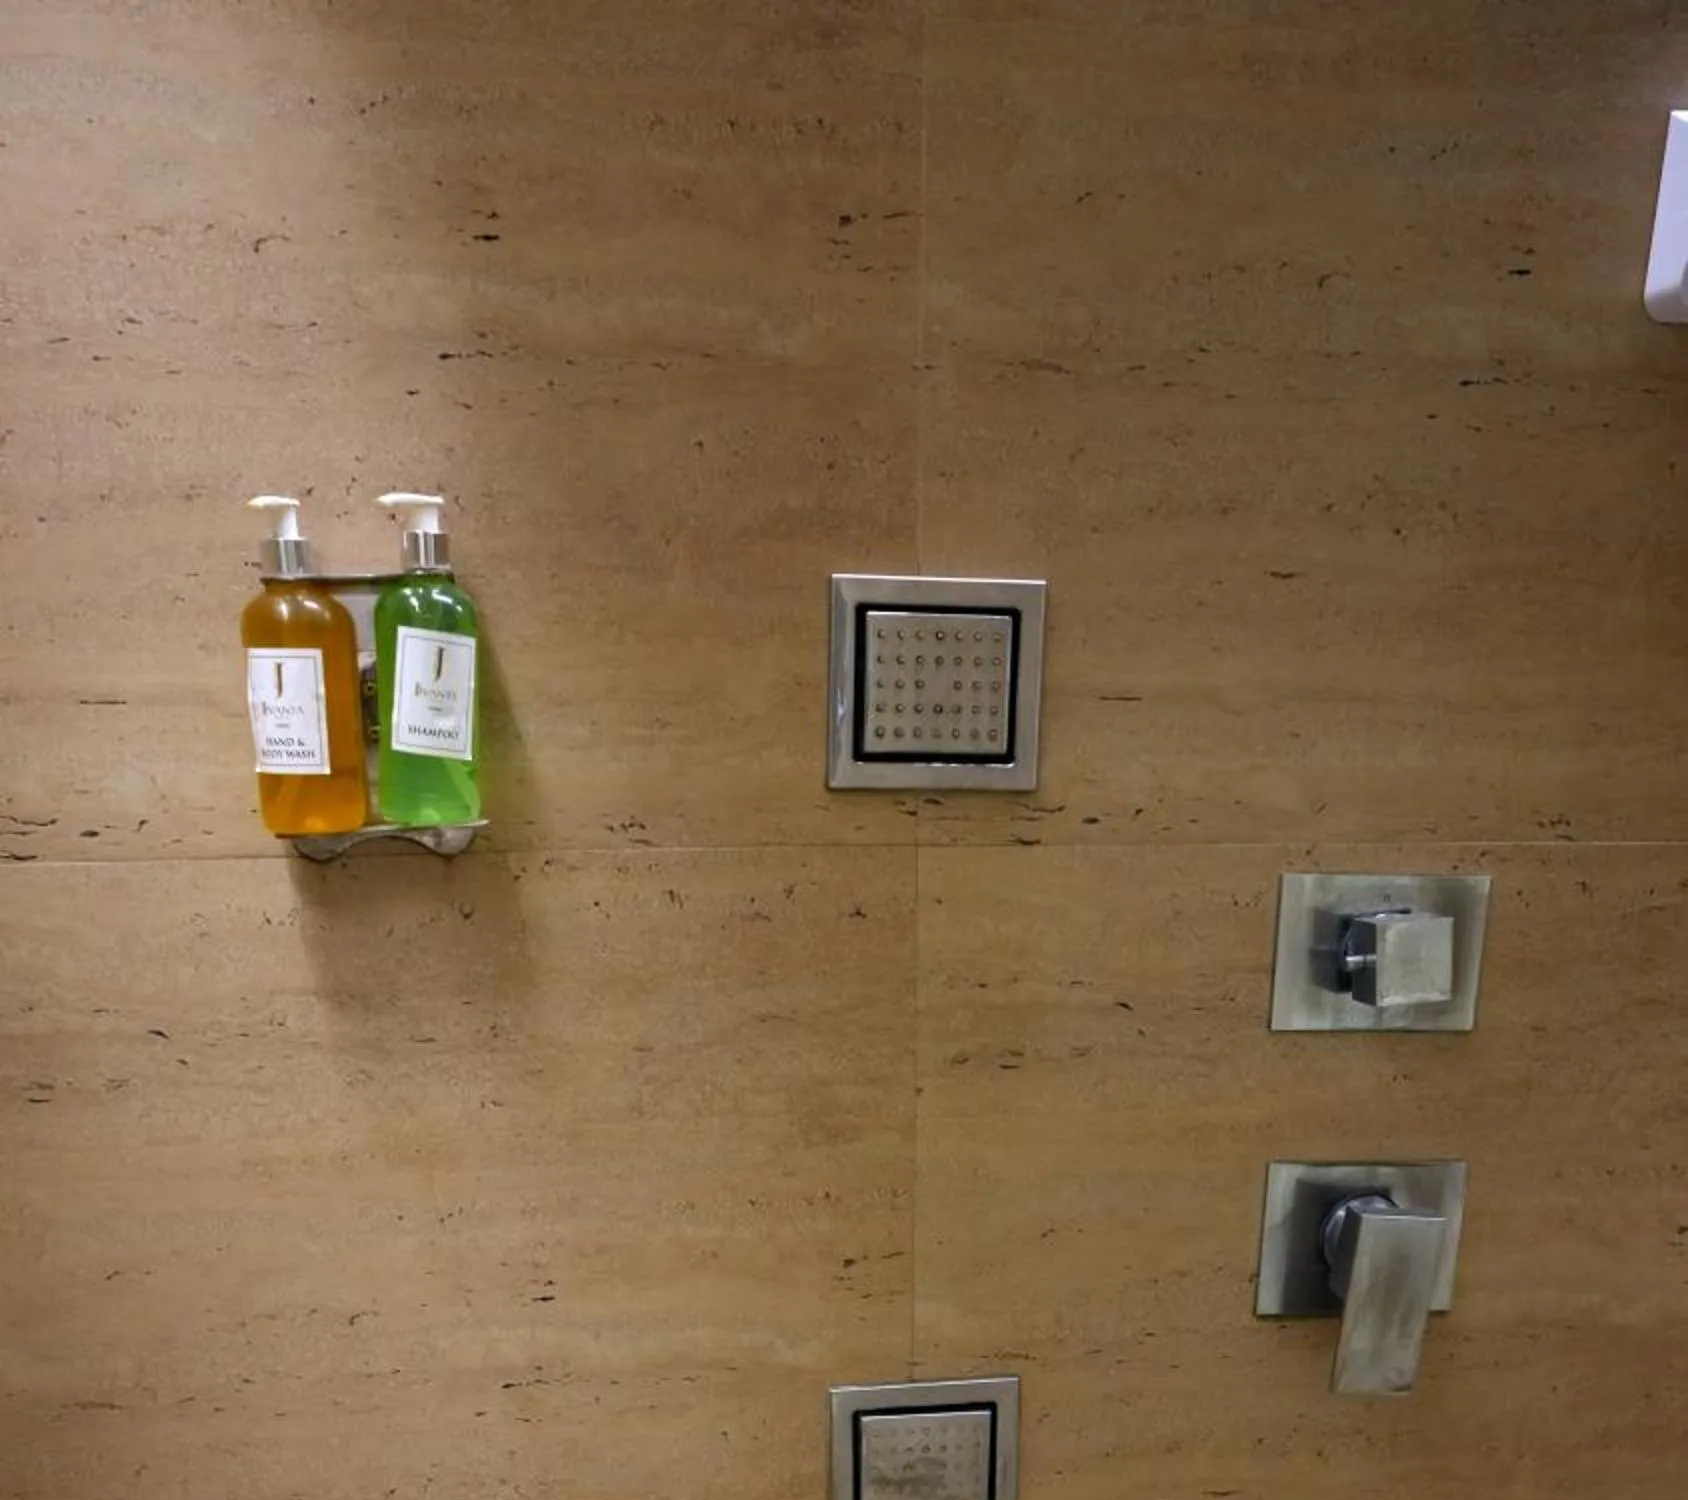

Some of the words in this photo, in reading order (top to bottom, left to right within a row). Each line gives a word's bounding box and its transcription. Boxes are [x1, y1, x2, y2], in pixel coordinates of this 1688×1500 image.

[435, 646, 445, 682] J
[274, 662, 284, 697] J
[407, 723, 460, 741] SHAMPOO
[265, 736, 295, 747] HAND
[285, 749, 316, 760] WASH
